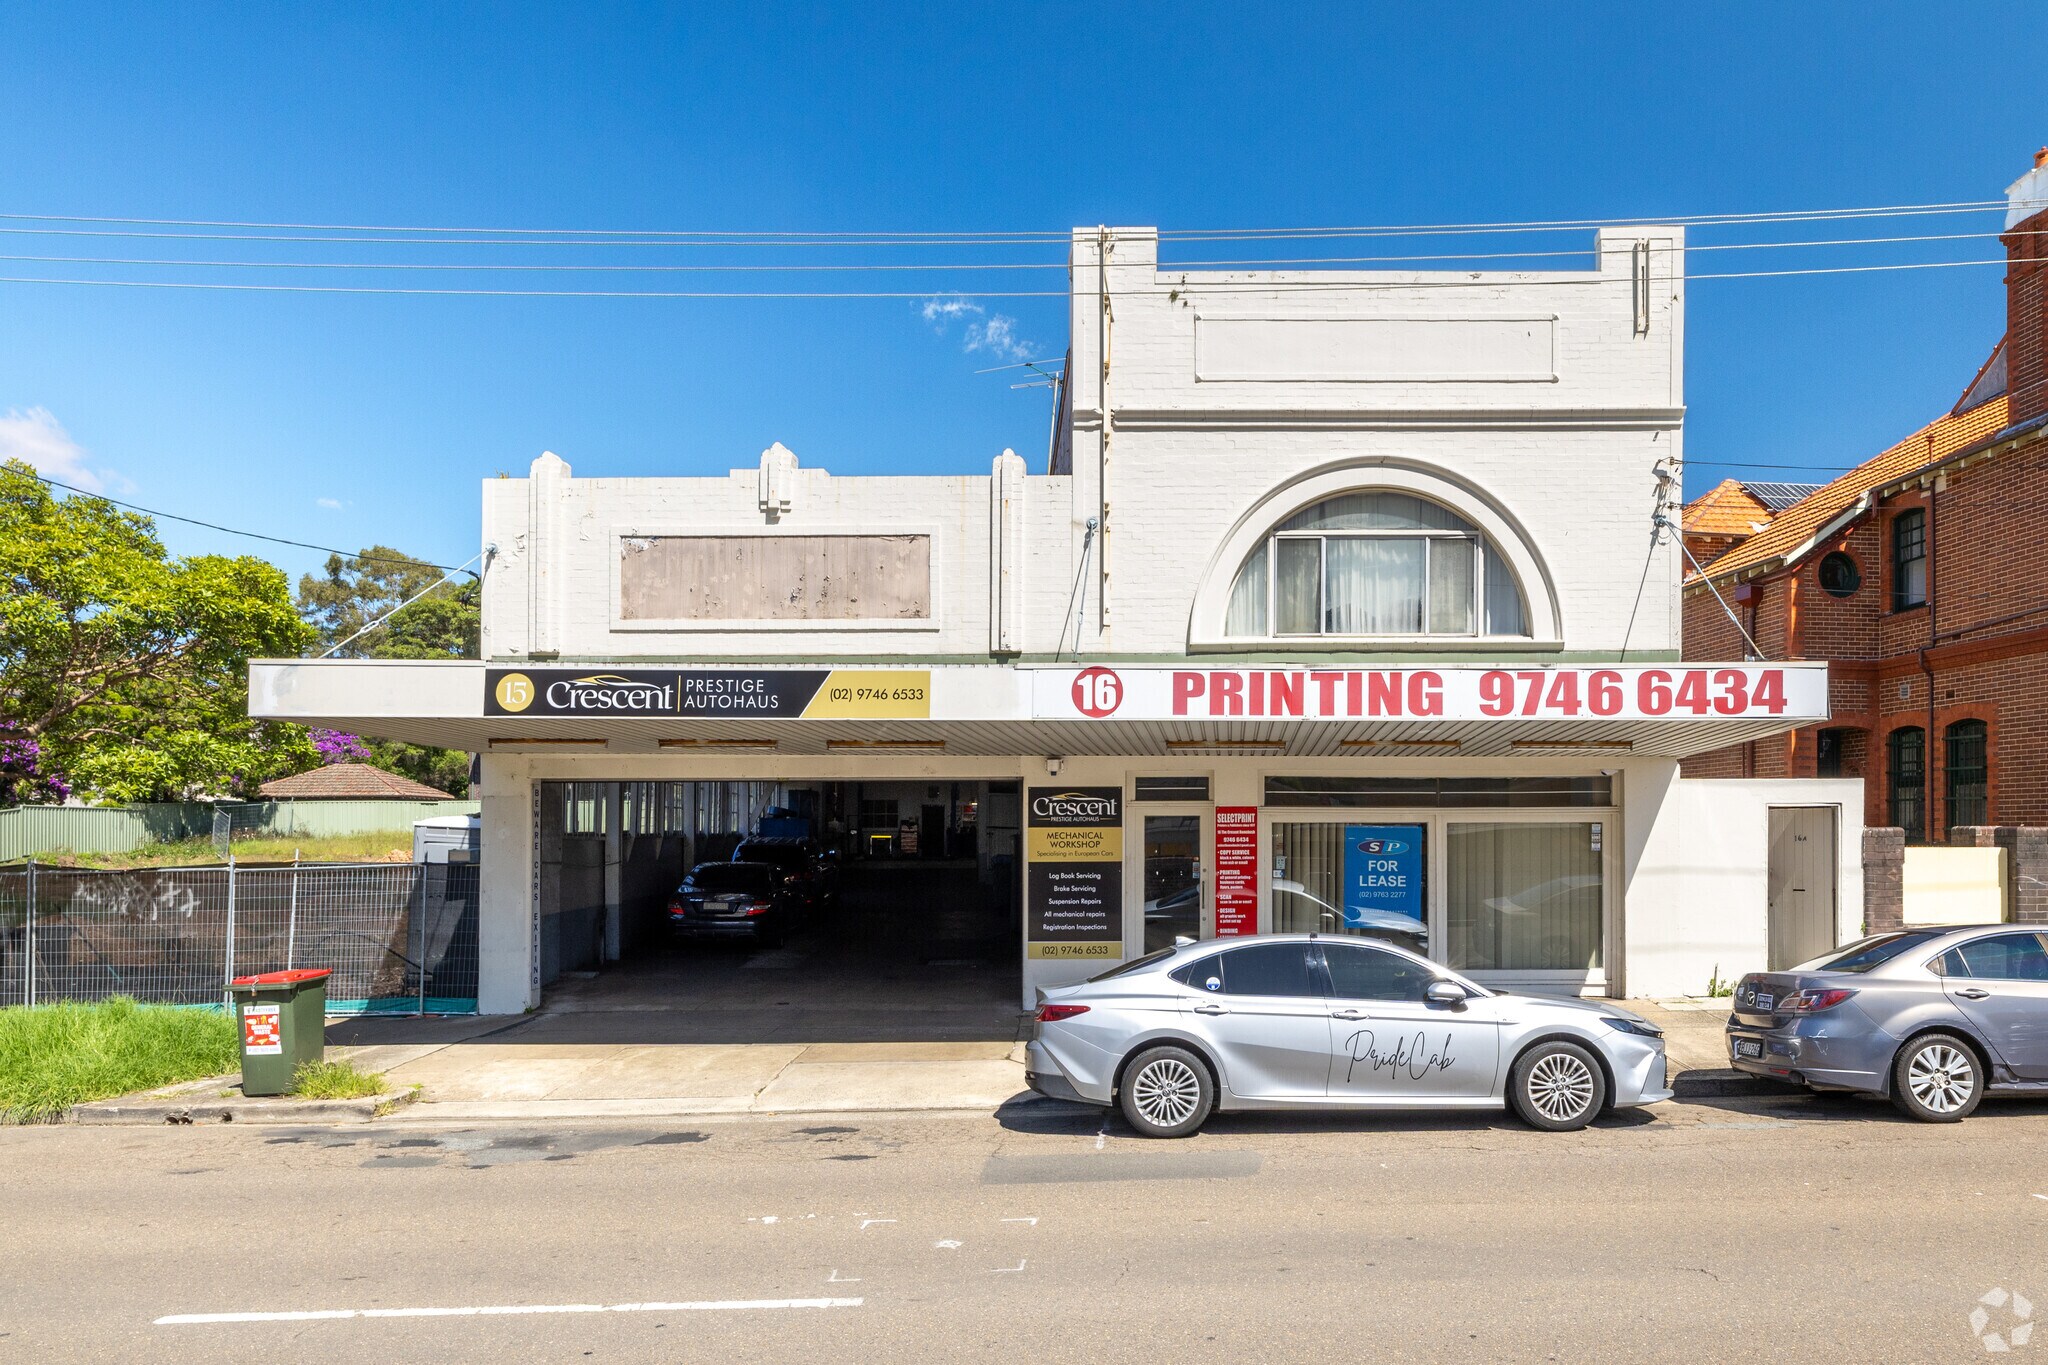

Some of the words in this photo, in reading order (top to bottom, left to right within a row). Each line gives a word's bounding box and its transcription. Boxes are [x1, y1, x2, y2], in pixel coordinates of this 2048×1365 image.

[504, 680, 527, 704] 15
[686, 679, 764, 692] PRESTIGE
[1076, 674, 1117, 710] 16
[546, 681, 674, 709] Crescent
[830, 688, 852, 702] (02)
[856, 688, 888, 700] 9746
[892, 688, 924, 700] 6533
[1172, 670, 1444, 716] PRINTING
[1479, 670, 1624, 716] 9746
[1637, 670, 1788, 716] 6434
[684, 695, 778, 708] AUTOHAUS
[1033, 797, 1118, 816] Crescent
[1217, 814, 1255, 823] SELECTPRINT
[1369, 842, 1400, 852] SP
[1368, 860, 1398, 872] FOR
[1360, 875, 1406, 887] LEASE
[1042, 946, 1058, 956] (02)
[1061, 946, 1083, 954] 9746
[1086, 946, 1108, 954] 6533
